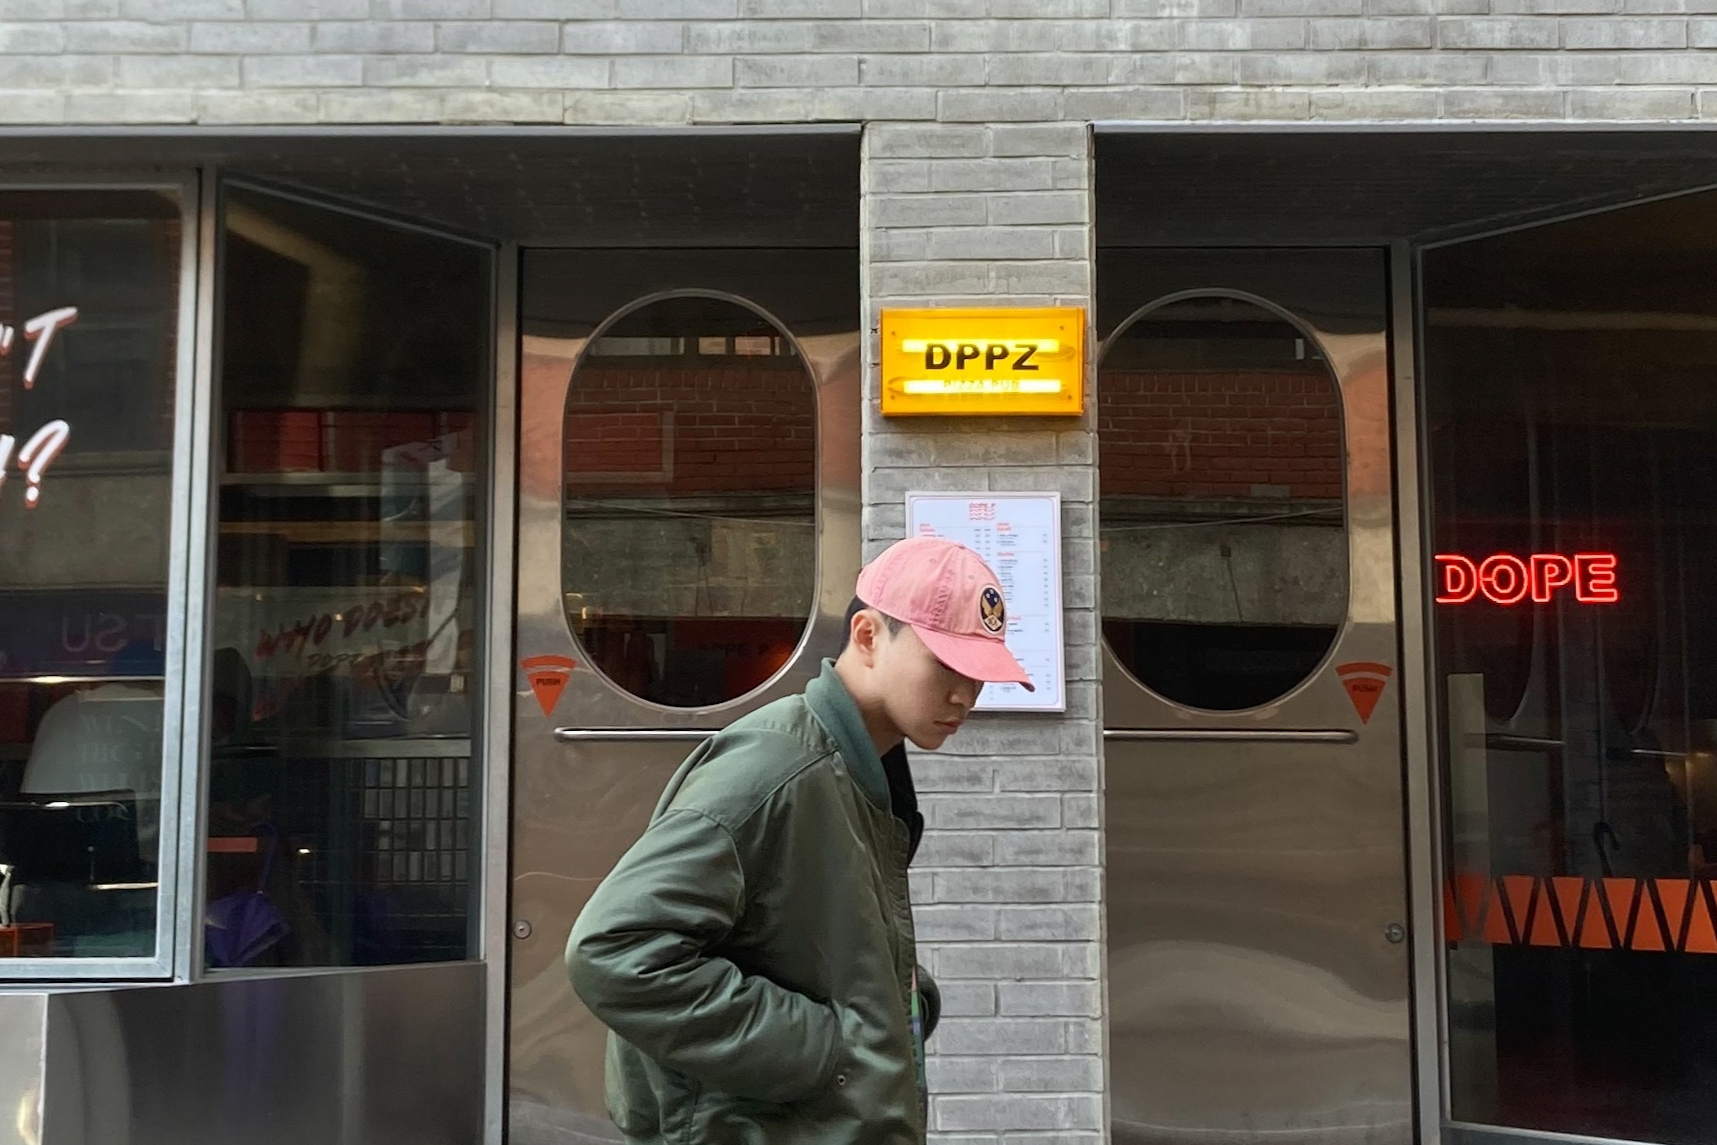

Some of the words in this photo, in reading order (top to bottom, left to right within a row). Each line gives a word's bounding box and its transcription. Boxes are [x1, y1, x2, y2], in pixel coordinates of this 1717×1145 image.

[925, 343, 1039, 370] DPPZ
[943, 379, 984, 390] PIZZA
[1434, 554, 1618, 604] DOPE
[536, 678, 561, 686] PUSH
[1352, 684, 1378, 692] PUSH
